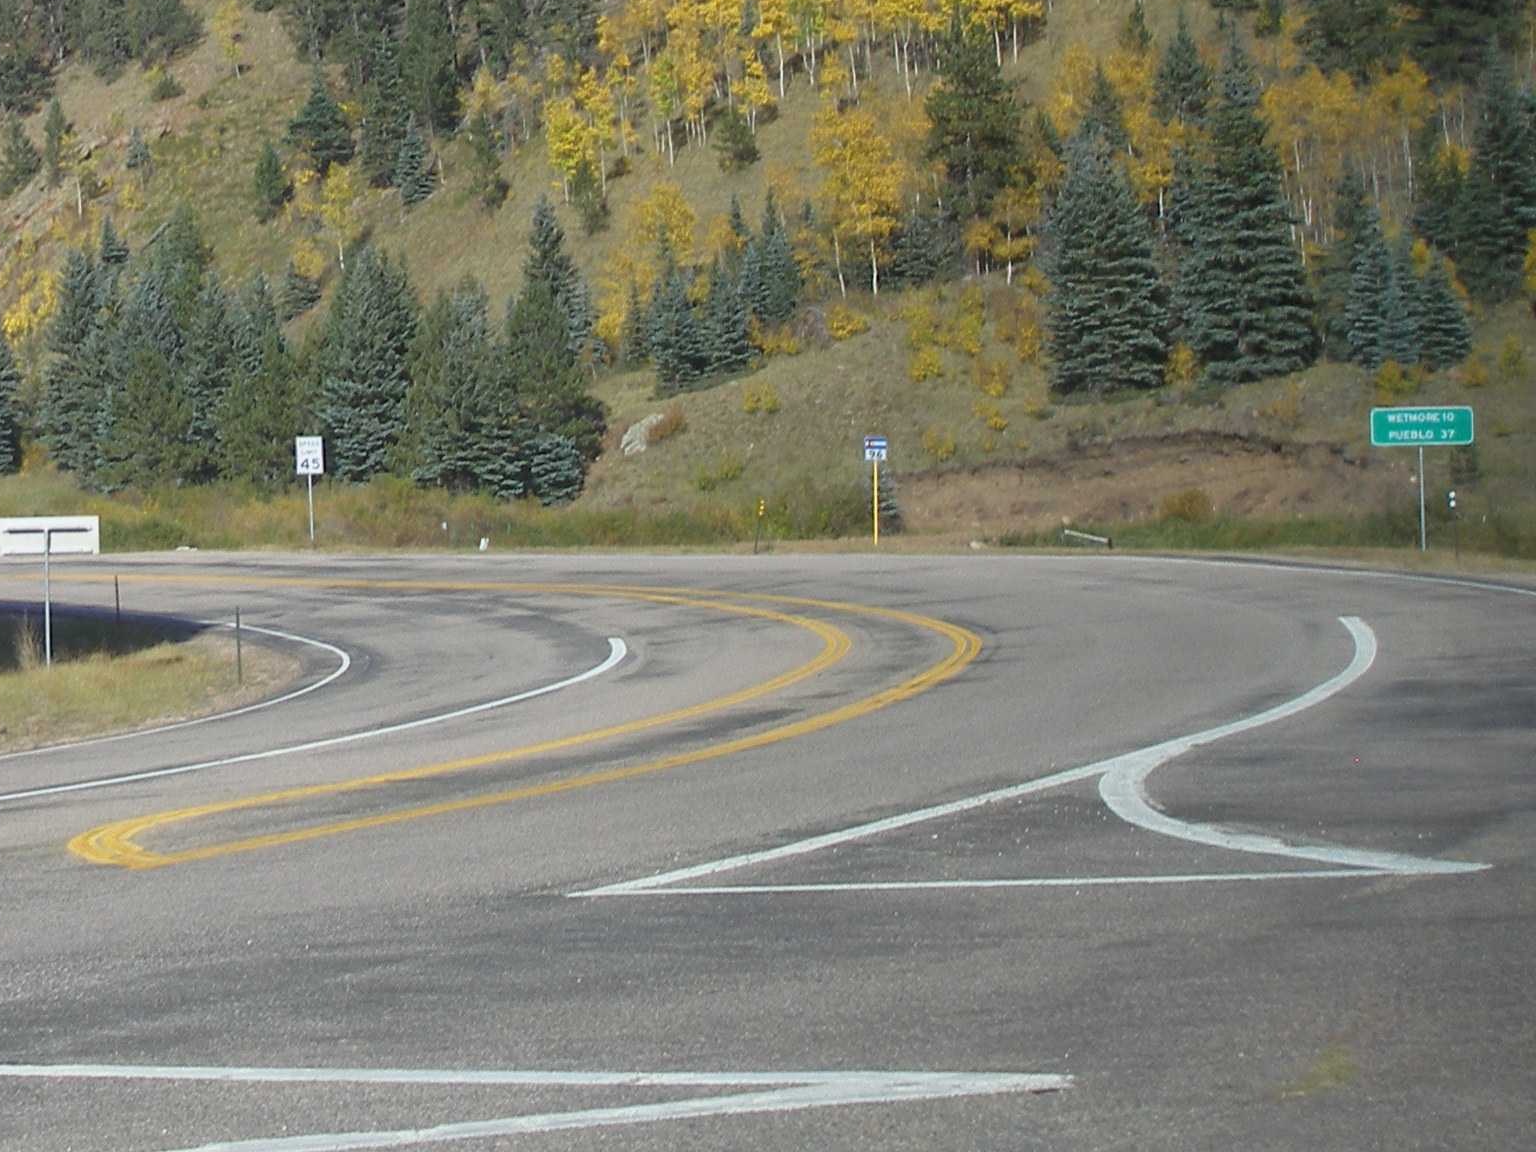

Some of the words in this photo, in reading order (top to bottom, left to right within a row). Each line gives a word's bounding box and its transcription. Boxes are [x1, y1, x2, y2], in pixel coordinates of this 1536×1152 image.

[1442, 412, 1455, 422] 10
[1388, 429, 1434, 440] PUEBLO
[1440, 429, 1455, 439] 37
[300, 458, 320, 469] 45
